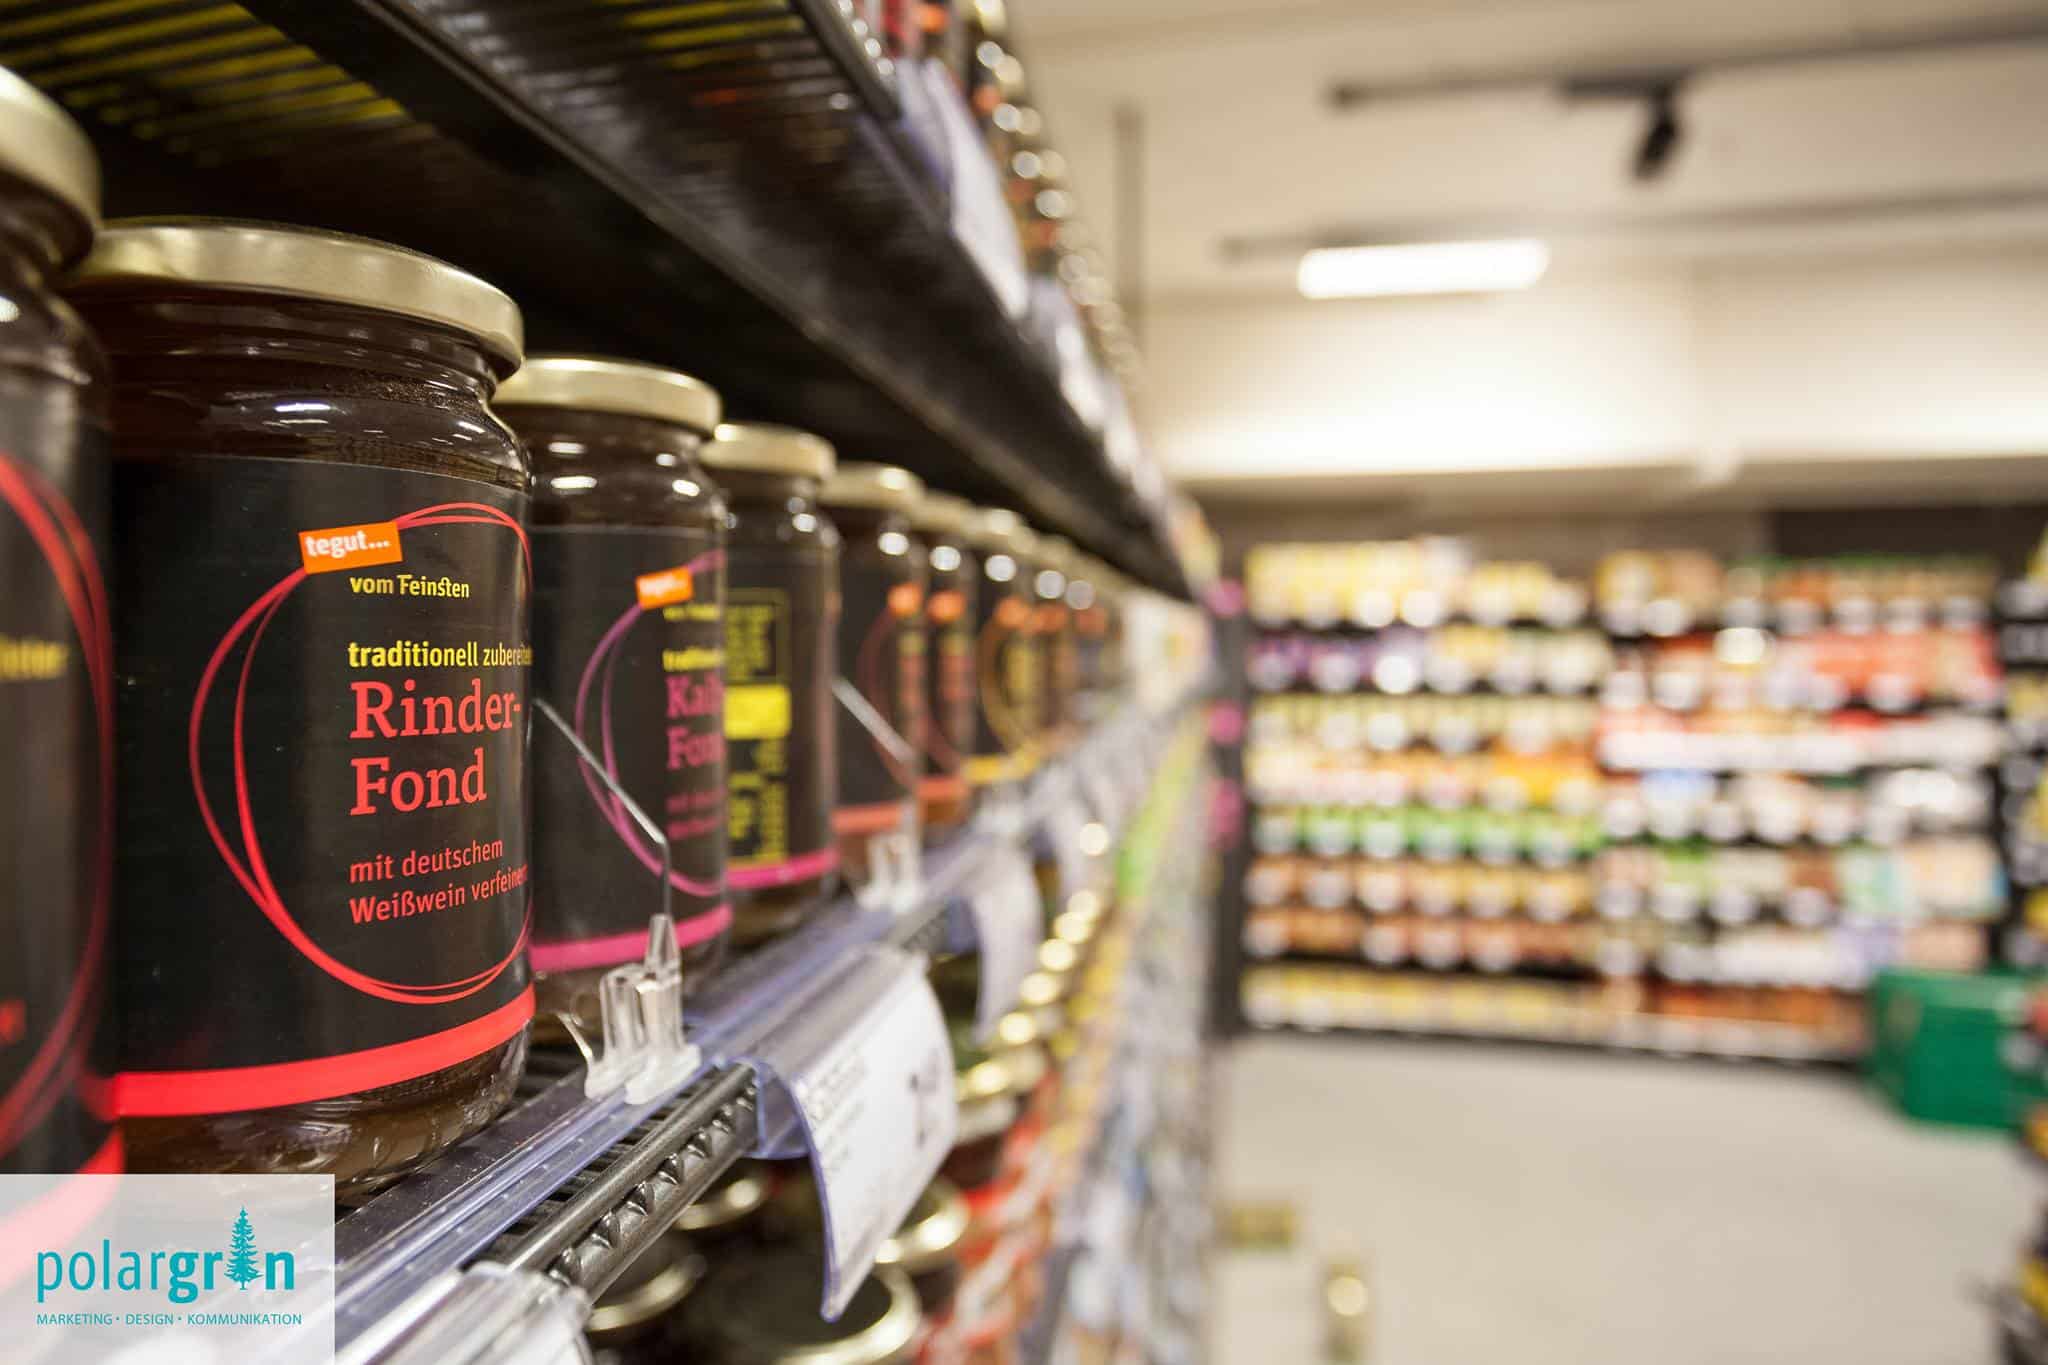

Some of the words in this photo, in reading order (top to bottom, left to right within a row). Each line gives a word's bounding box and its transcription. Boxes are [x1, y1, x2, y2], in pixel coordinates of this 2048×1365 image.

[304, 530, 391, 559] tegut...
[350, 577, 394, 595] vom
[397, 574, 470, 599] Feinsten
[348, 640, 478, 668] traditionell
[349, 678, 522, 739] Rinder-
[349, 747, 488, 816] Fond
[349, 854, 395, 884] mit
[402, 839, 504, 877] deutschem
[349, 884, 466, 924] Weißwein
